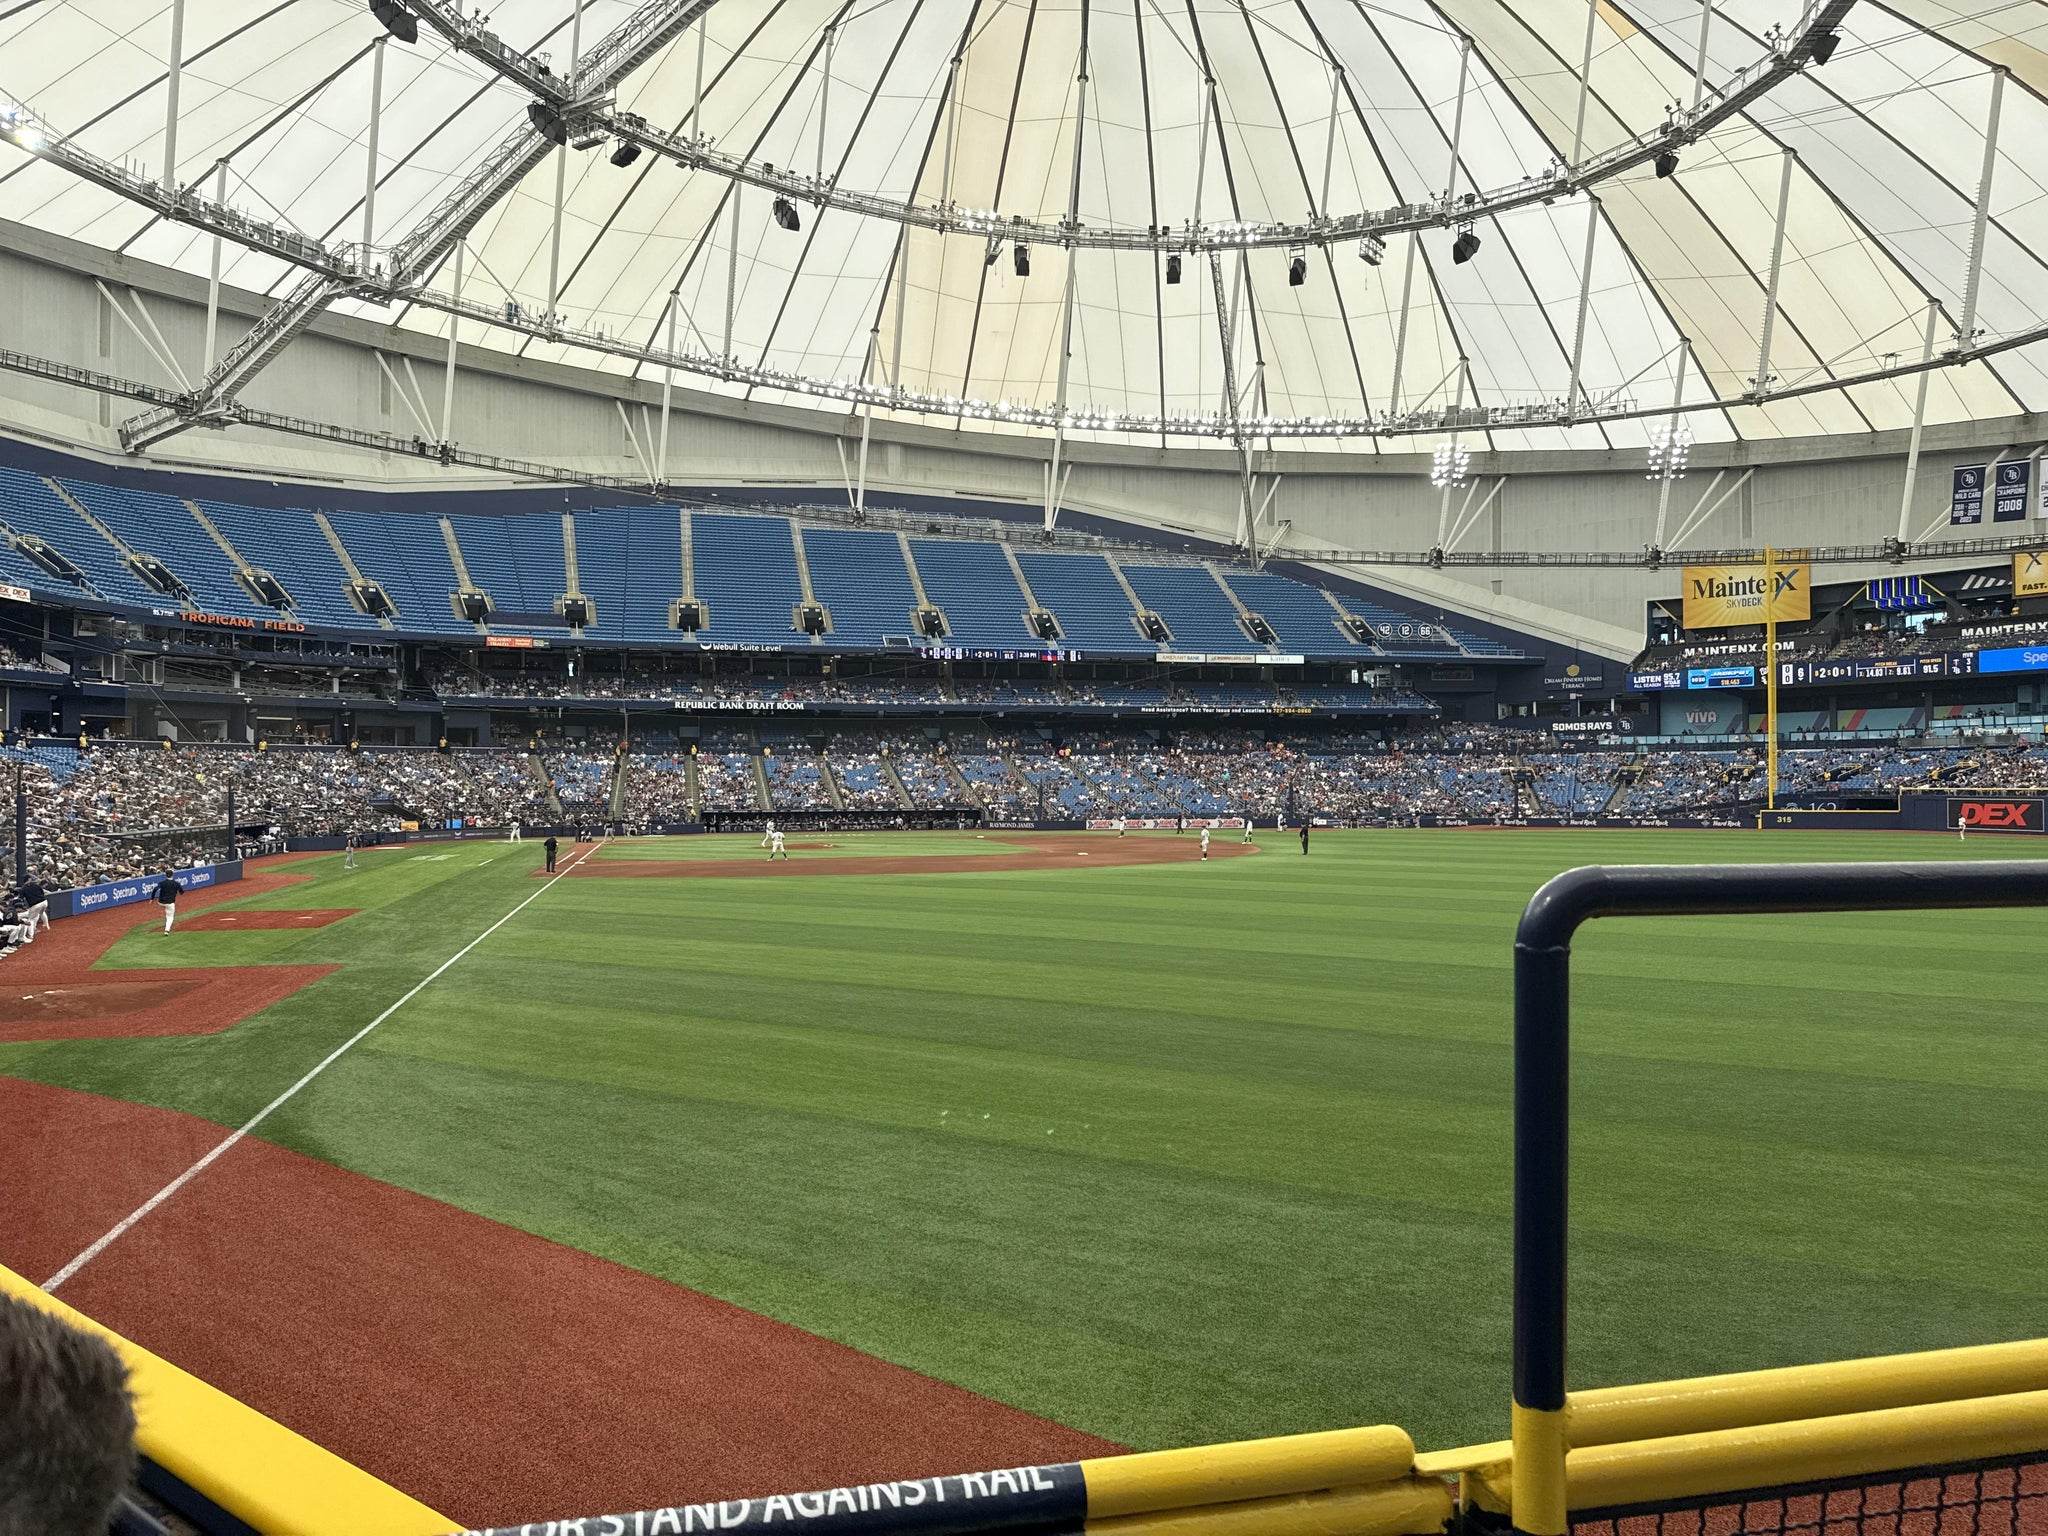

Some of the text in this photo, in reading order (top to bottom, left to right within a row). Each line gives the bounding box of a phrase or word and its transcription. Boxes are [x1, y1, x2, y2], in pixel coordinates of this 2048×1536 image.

[1997, 487, 2026, 496] CHAMPIONS
[1998, 498, 2023, 513] 2008
[1692, 568, 1800, 604] MaintenX
[1726, 597, 1763, 609] SKYDECK
[179, 611, 256, 628] TROPICANA
[264, 620, 305, 632] FIELD
[1379, 625, 1391, 635] 42
[1401, 625, 1411, 635] 12
[1420, 626, 1431, 636] 66
[1961, 621, 2048, 637] MAINTENX
[713, 643, 782, 652] Webull Suite Level
[1798, 668, 1804, 677] 6
[1820, 668, 1826, 677] 2
[1833, 667, 1839, 677] 0
[1847, 666, 1852, 676] 1
[1633, 672, 1681, 684] LISTEN 95.7
[675, 701, 805, 710] REPUBLIC BANK DRAFT ROOM
[1686, 711, 1717, 723] VIVA
[1552, 722, 1612, 731] SOMOS RAYS
[1620, 720, 1631, 730] TB
[1960, 803, 2031, 826] DEX
[191, 873, 210, 884] Spectrum
[112, 887, 138, 901] Spectrum
[80, 892, 109, 908] Spectrum
[600, 1499, 750, 1536] STAND
[763, 1475, 946, 1523] AGAINST
[950, 1466, 1054, 1499] RAIL
